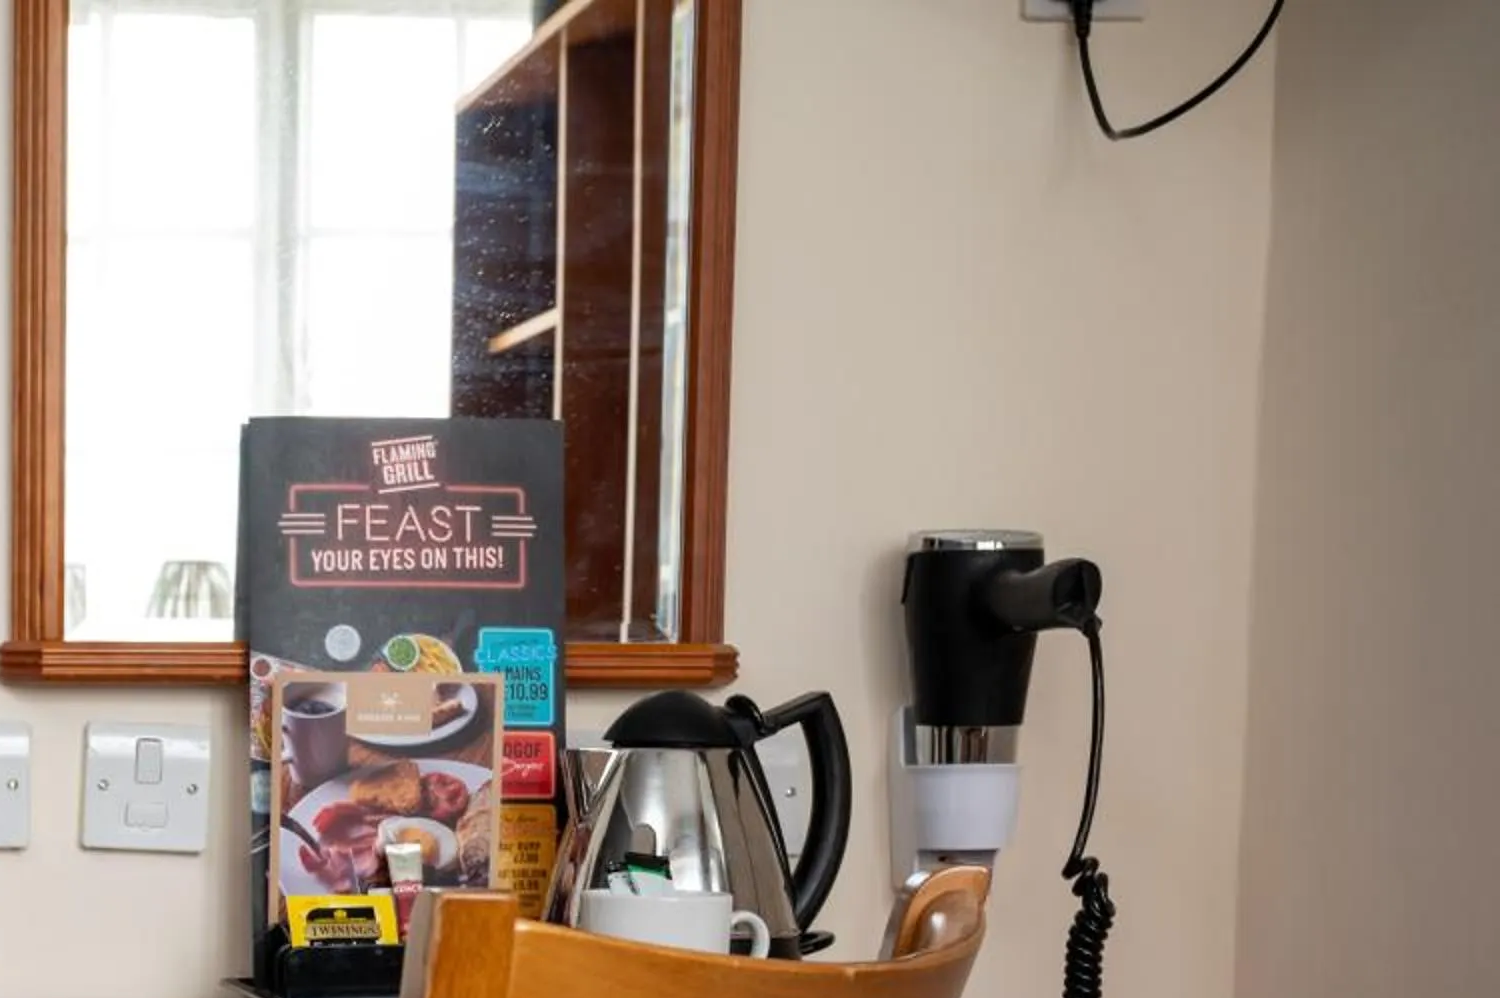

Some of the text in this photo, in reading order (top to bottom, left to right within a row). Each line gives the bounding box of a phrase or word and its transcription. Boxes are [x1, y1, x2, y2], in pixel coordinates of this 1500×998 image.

[373, 441, 437, 465] FLAMING
[383, 460, 435, 485] GRILL
[337, 504, 482, 543] FEAST
[311, 546, 504, 573] YOUR EYES ON THIS!
[503, 742, 542, 758] OGOF
